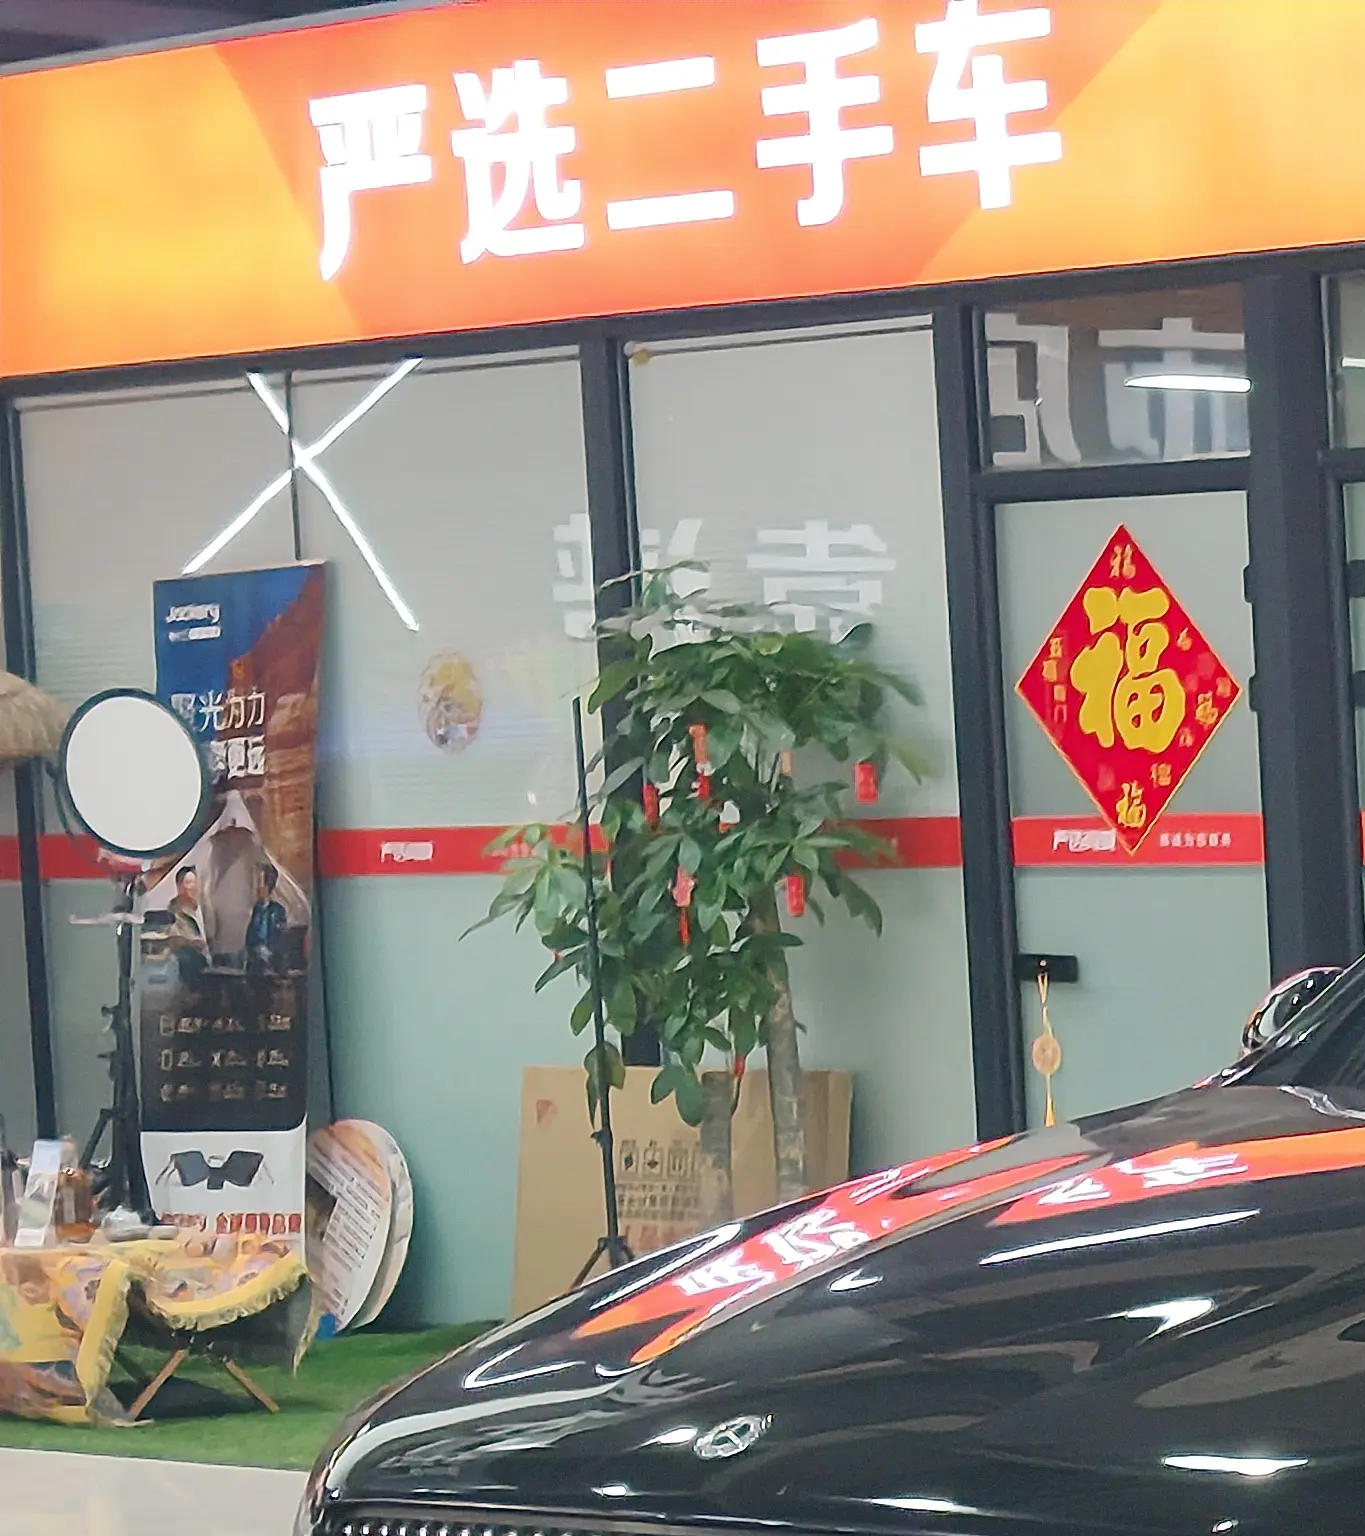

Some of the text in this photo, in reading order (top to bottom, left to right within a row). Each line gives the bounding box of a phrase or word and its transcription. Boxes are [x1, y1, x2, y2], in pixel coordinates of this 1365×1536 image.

[309, 0, 1062, 281] 严选二手车
[1070, 587, 1187, 754] 福
